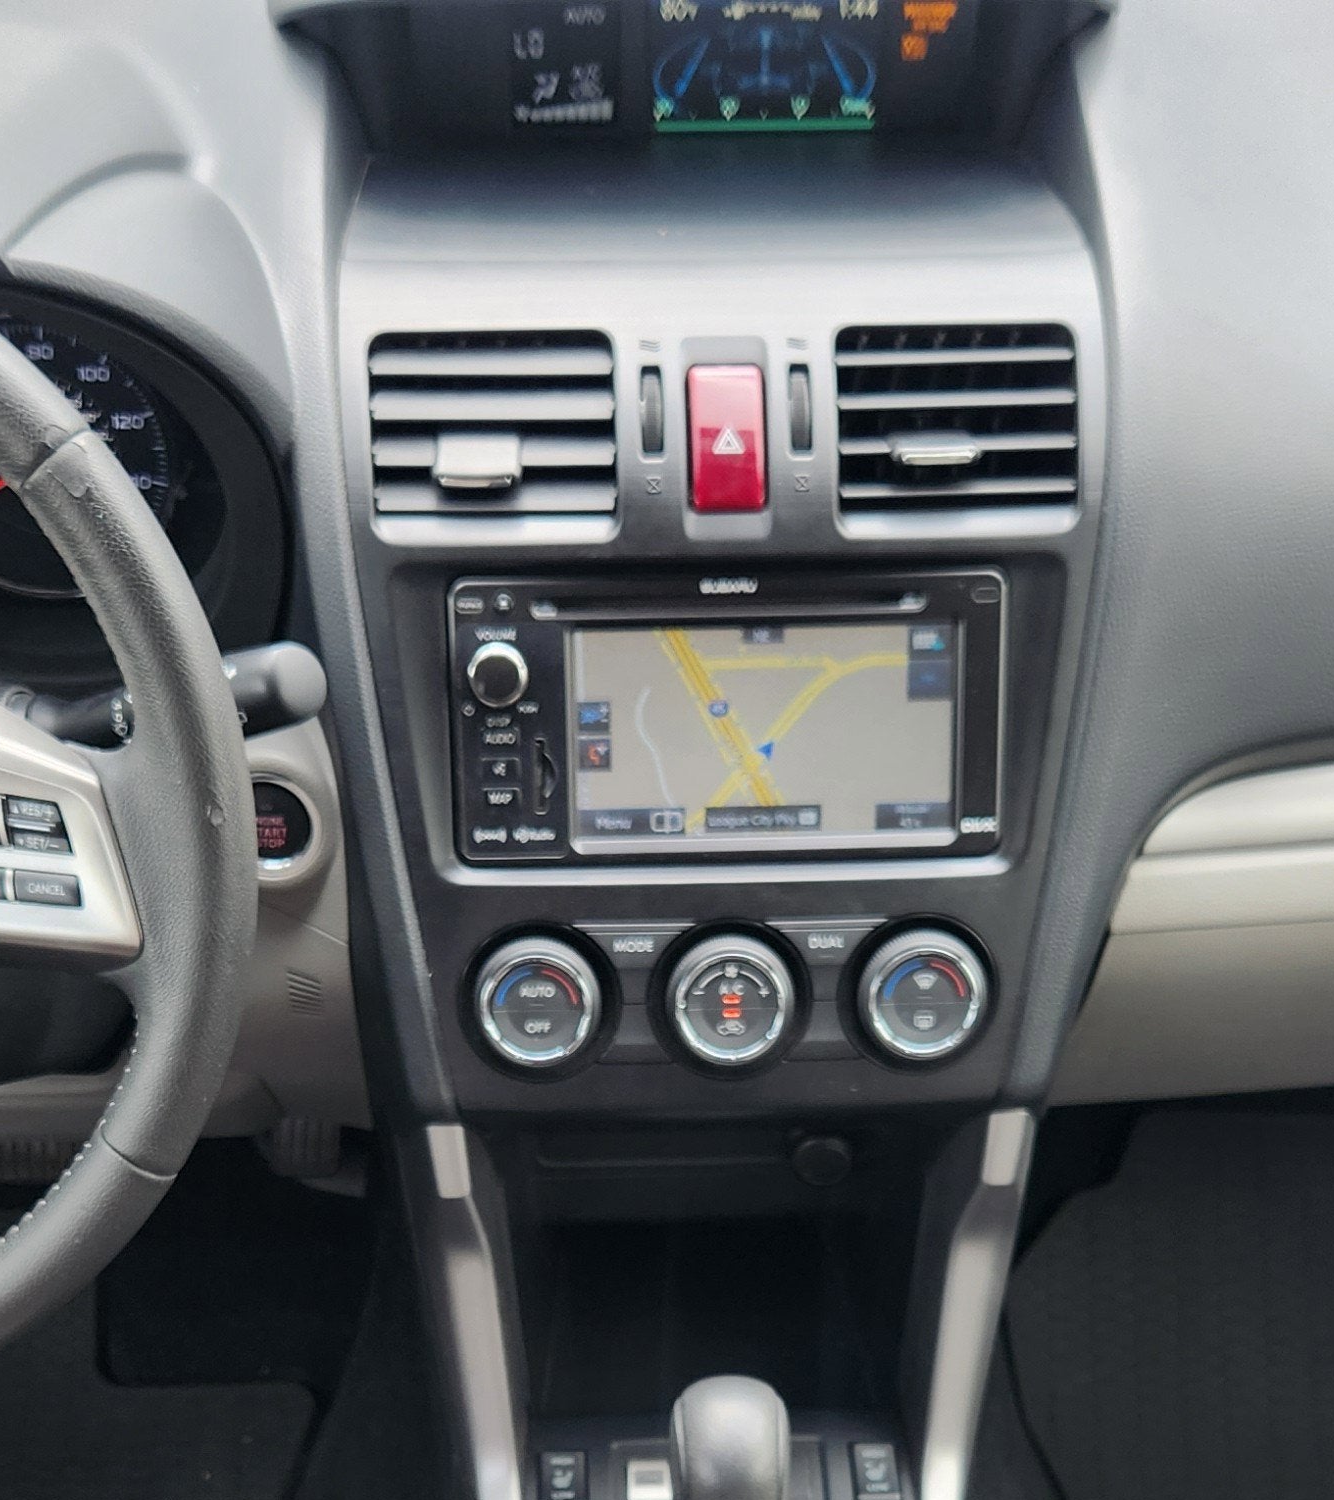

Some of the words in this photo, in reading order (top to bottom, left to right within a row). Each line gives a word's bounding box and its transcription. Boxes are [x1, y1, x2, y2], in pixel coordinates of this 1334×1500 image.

[76, 365, 110, 382] 100
[111, 412, 145, 430] 120
[475, 625, 516, 641] VOLUME
[484, 731, 516, 745] AUDIO
[594, 815, 632, 831] Menu
[28, 882, 66, 896] CANCEL
[613, 936, 654, 953] MODE
[808, 933, 844, 949] DUAL
[519, 982, 555, 998] AUTO
[524, 1020, 551, 1034] OFF
